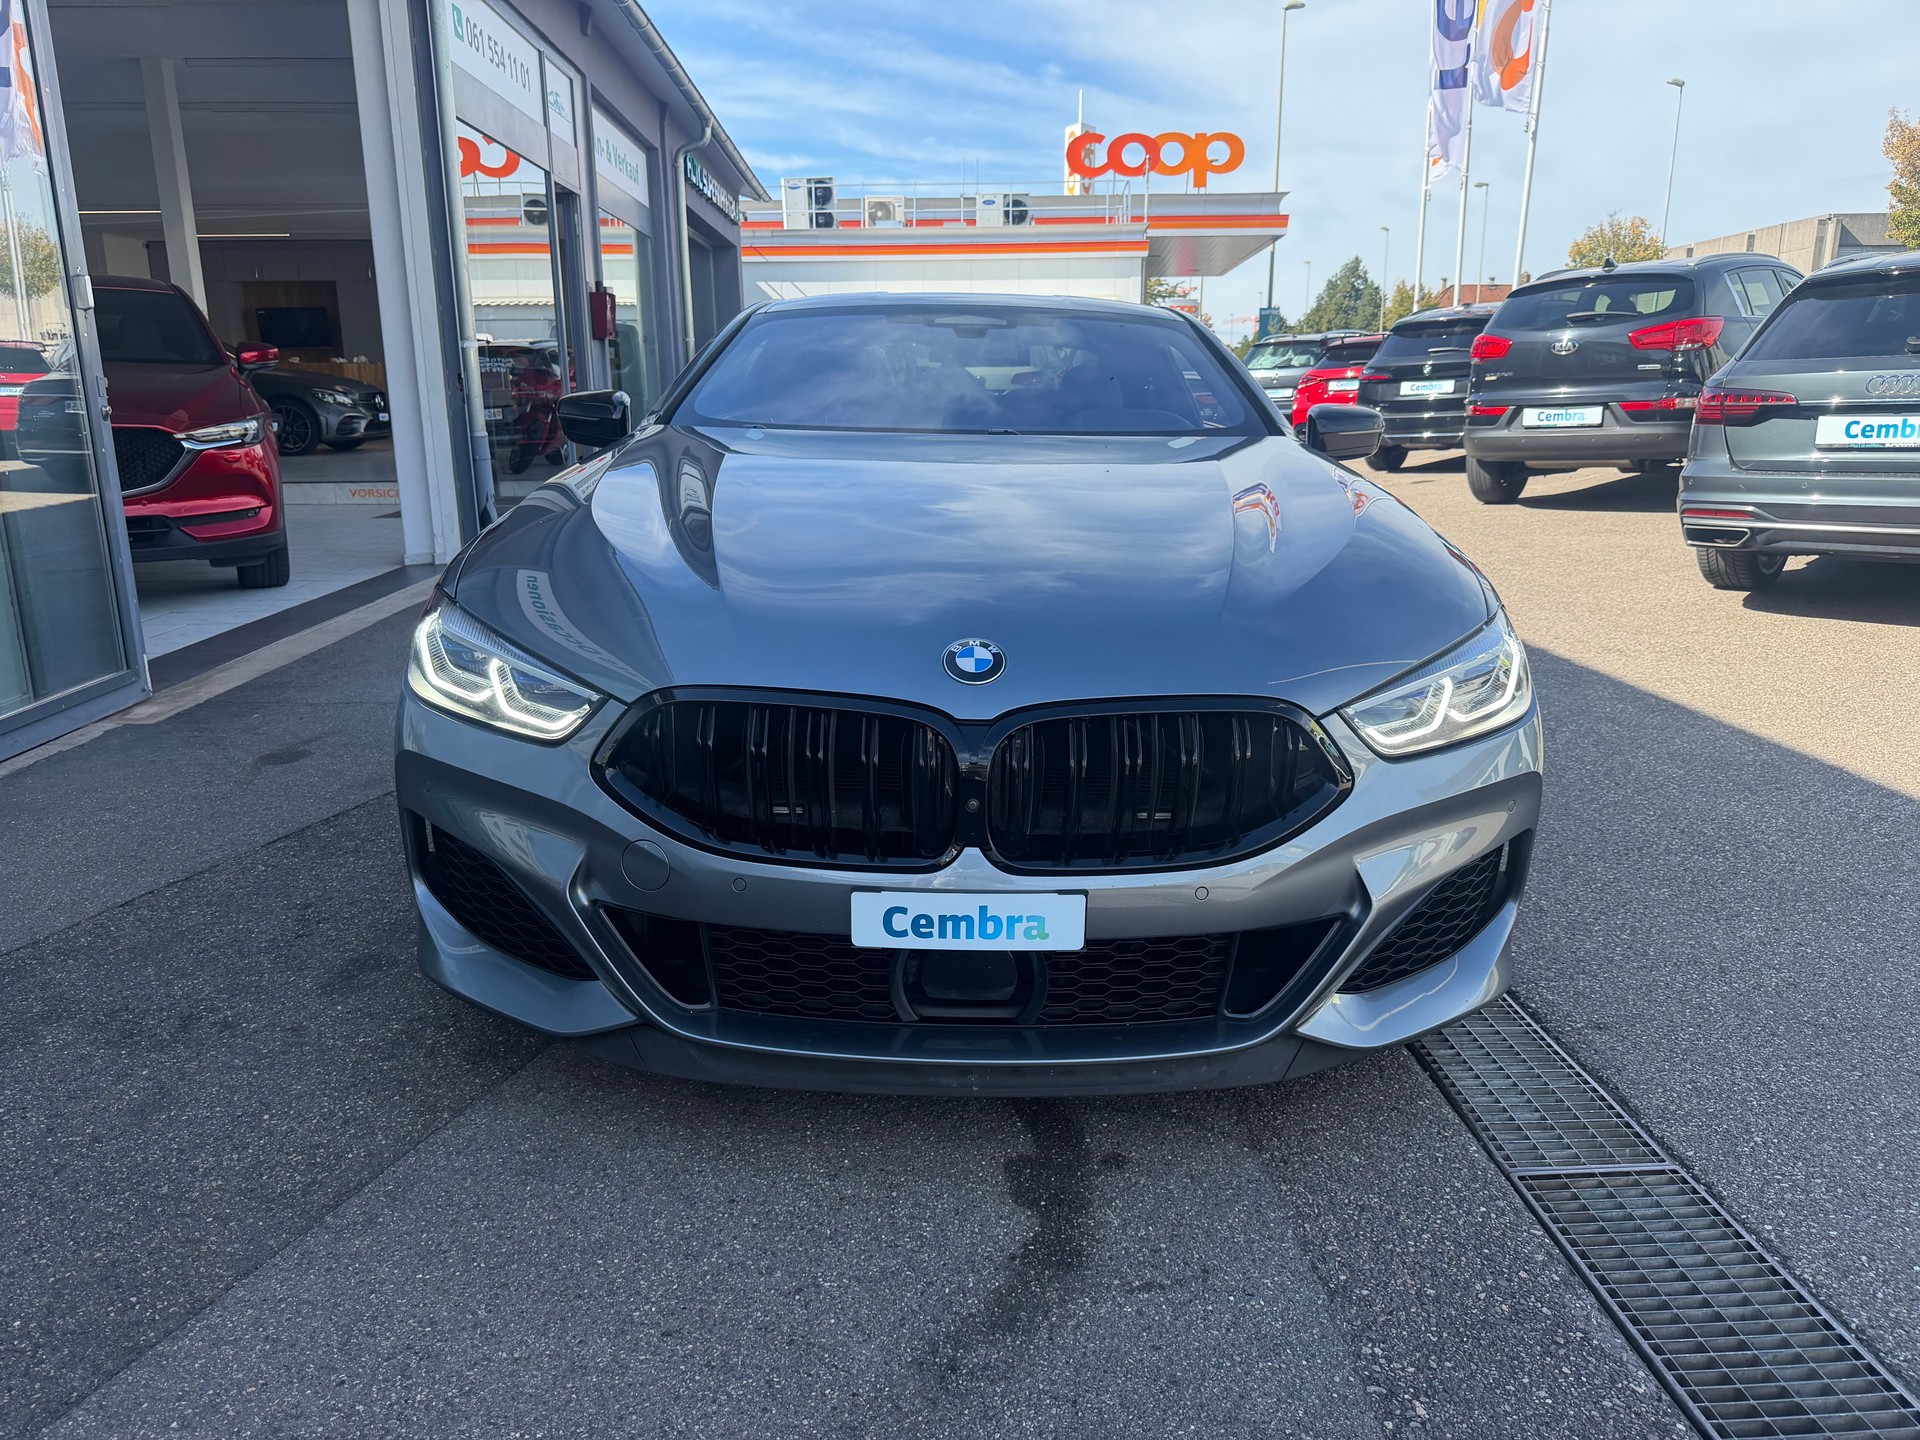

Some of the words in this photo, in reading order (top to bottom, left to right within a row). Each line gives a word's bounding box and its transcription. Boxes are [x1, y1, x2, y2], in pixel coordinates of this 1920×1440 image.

[465, 16, 485, 58] 061
[488, 34, 506, 74] 554
[507, 52, 519, 84] 11
[520, 62, 531, 93] 01
[605, 139, 612, 165] &
[612, 144, 639, 186] Verkauf
[1066, 132, 1246, 188] coop
[1554, 341, 1574, 351] KIA
[1410, 382, 1443, 392] Cembra
[1537, 409, 1585, 422] Cembra
[882, 905, 1050, 941] Cembra
